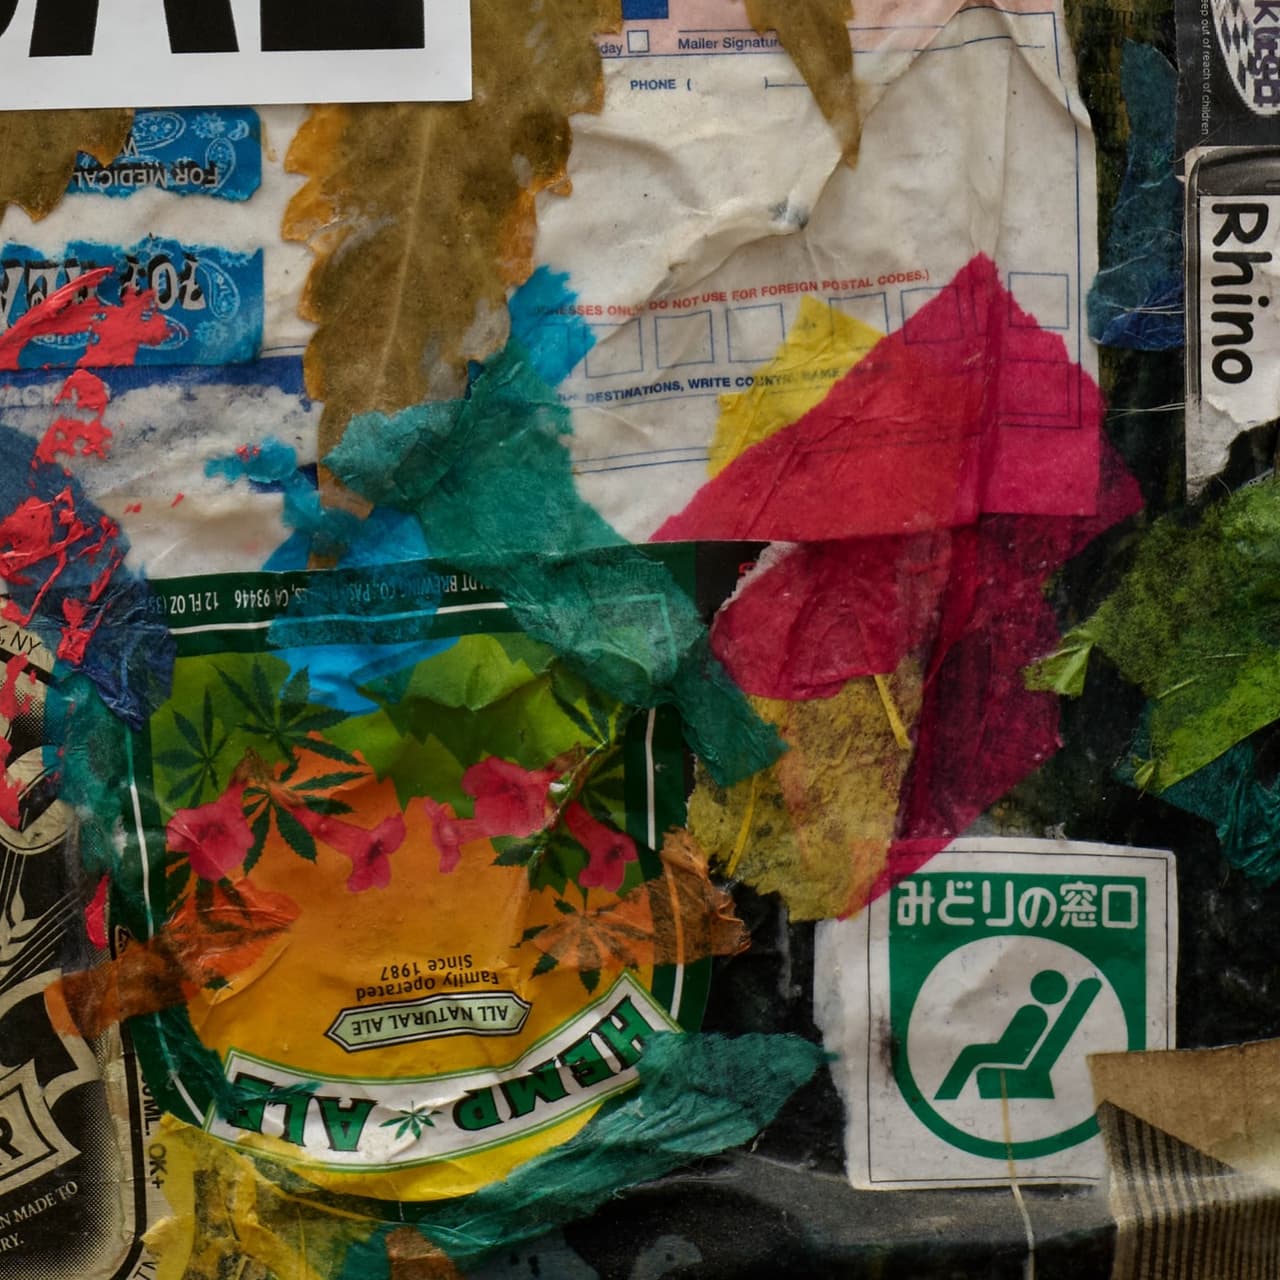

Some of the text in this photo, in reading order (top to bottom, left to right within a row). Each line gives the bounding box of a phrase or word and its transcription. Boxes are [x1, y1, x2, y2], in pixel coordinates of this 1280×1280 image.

[678, 37, 719, 50] Mailer
[629, 78, 677, 91] PHONE
[700, 291, 728, 304] USE
[760, 280, 818, 298] FOREIGN
[821, 276, 874, 293] POSTAL
[1210, 201, 1270, 385] Rhino
[584, 376, 732, 405] DESTINATIONS, WRITE
[895, 878, 1140, 931] みどりの窓口
[380, 953, 474, 980] Since 1987
[355, 970, 502, 1002] Family Operated
[387, 1005, 475, 1031] NATURAL
[452, 993, 657, 1133] HEMP
[12, 1195, 57, 1227] MADE
